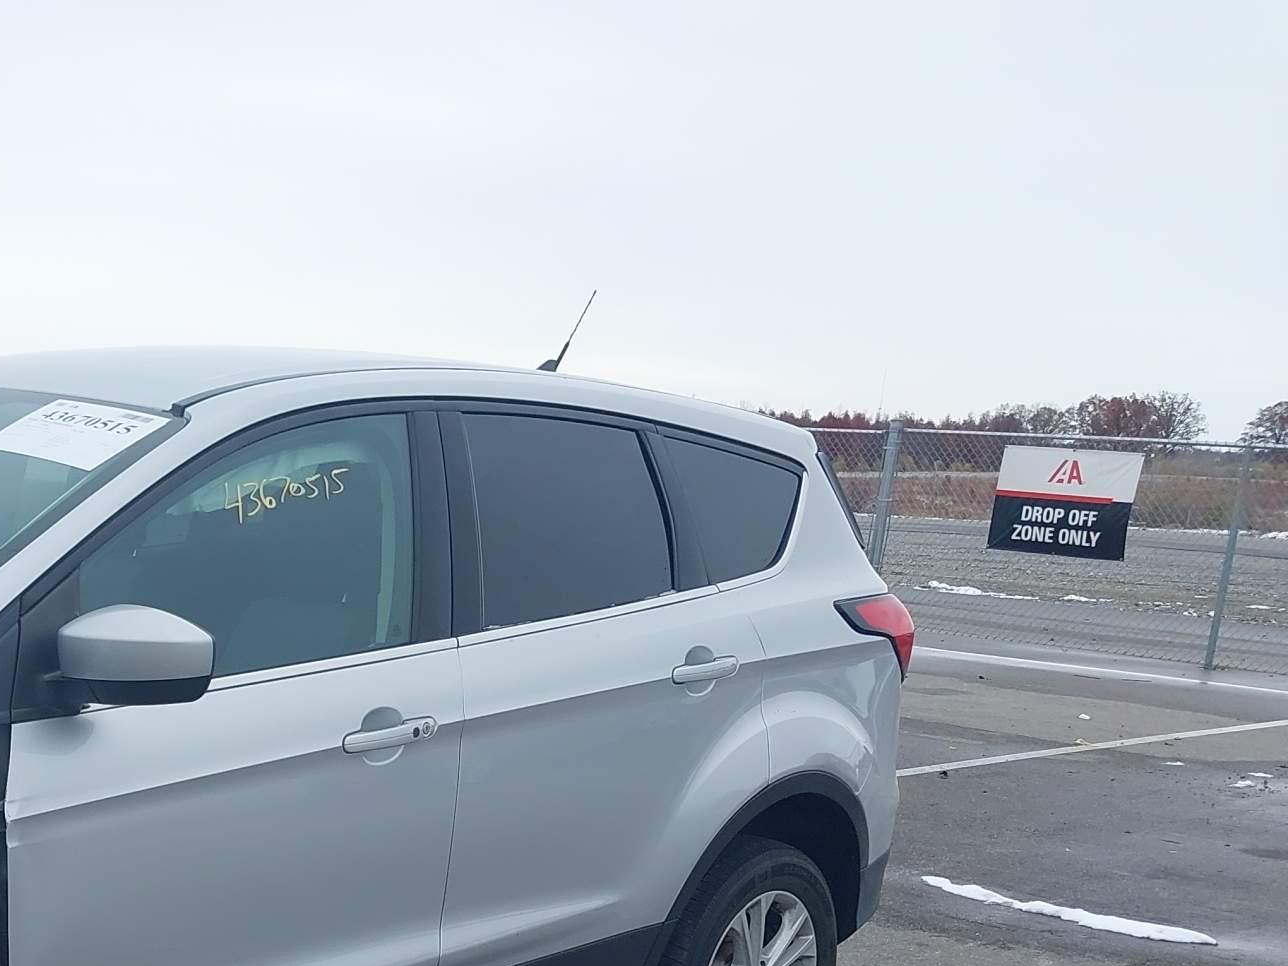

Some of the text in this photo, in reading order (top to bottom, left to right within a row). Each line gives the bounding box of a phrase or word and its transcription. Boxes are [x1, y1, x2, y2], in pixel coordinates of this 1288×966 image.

[42, 410, 139, 435] 43670515
[224, 468, 349, 524] 43670515
[1020, 505, 1099, 527] DROP OFF
[1010, 524, 1102, 548] ZONE ONLY
